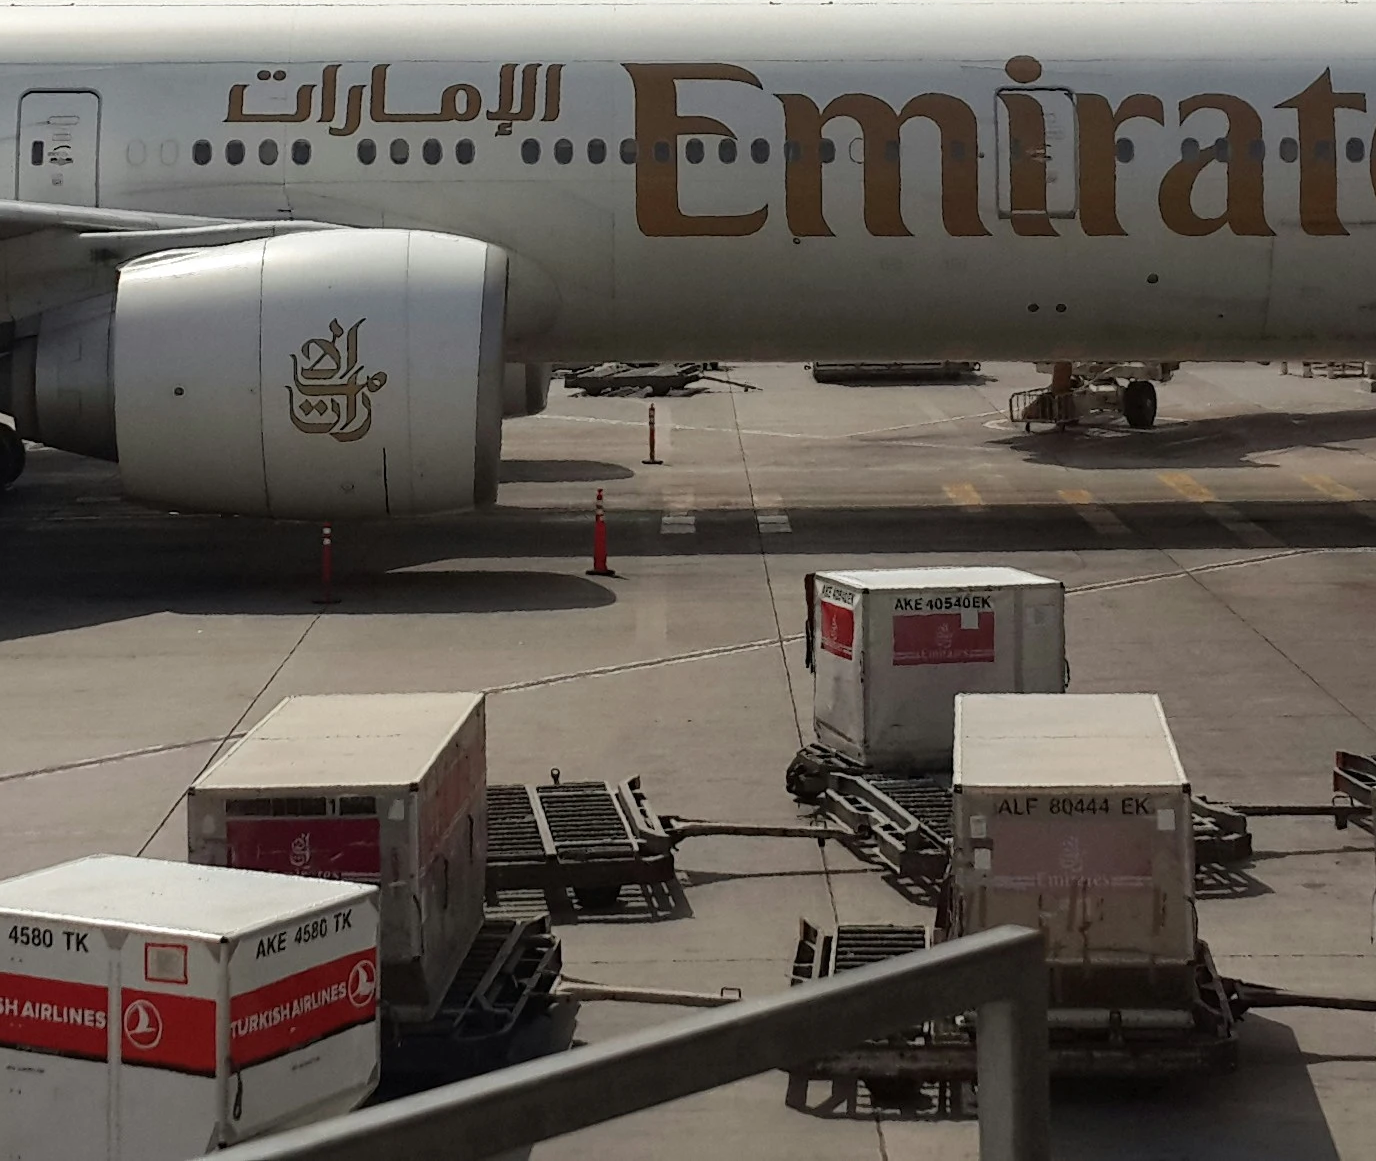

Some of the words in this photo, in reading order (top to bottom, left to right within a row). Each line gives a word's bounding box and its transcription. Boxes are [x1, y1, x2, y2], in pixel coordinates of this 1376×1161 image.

[224, 63, 566, 137] الإمارات
[894, 597, 923, 611] AKE
[998, 797, 1038, 815] ALF
[1049, 796, 1110, 816] 80444
[1121, 796, 1150, 815] EK
[8, 925, 53, 948] 4580
[62, 930, 89, 953] TK
[256, 931, 287, 960] AKE
[294, 918, 328, 944] 4580
[333, 908, 352, 933] TK
[20, 1000, 107, 1030] AIRLINES
[230, 1002, 290, 1039] TURKISH
[291, 981, 347, 1019] AIRLINES
